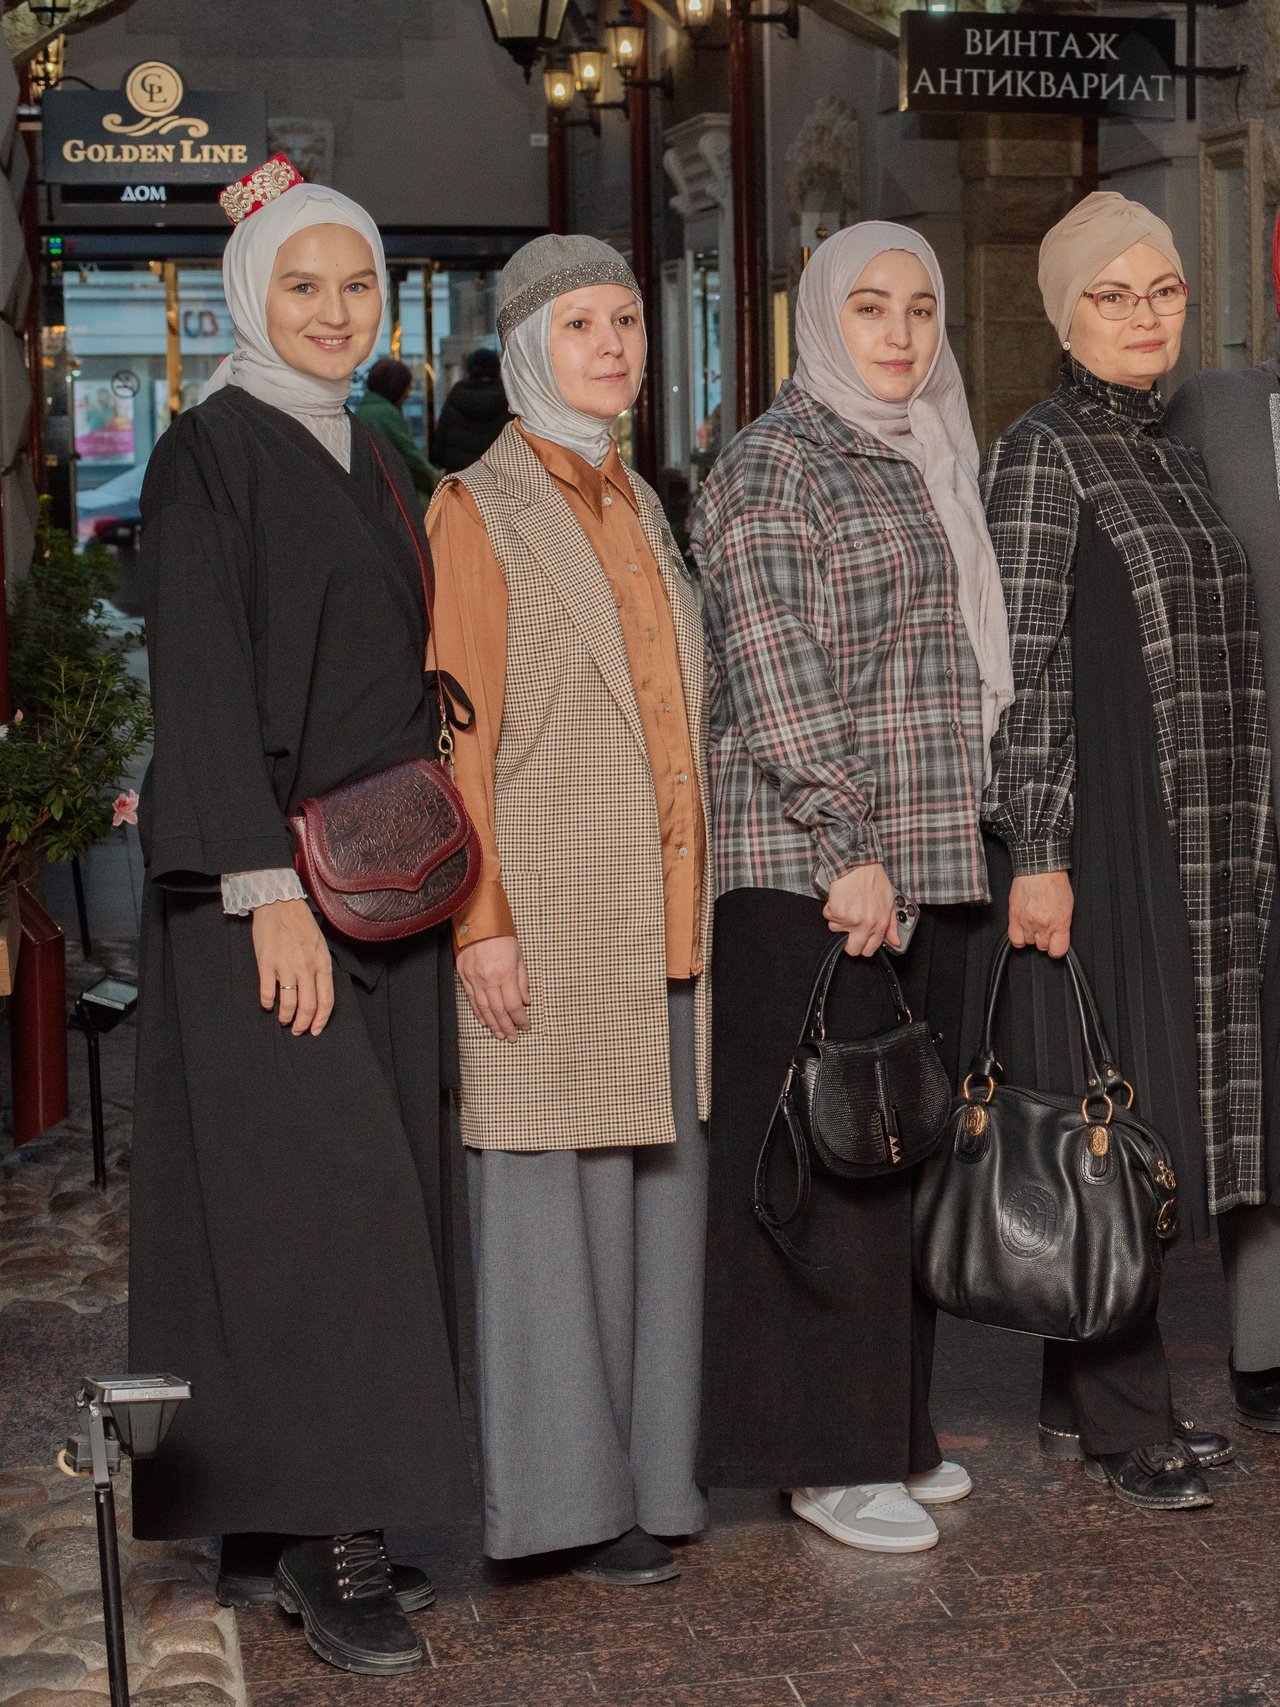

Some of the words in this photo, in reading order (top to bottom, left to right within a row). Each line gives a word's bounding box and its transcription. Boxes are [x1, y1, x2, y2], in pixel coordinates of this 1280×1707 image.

[964, 28, 1119, 60] ВИНТАЖ
[912, 68, 1172, 101] АНТИКВАРИАТ
[62, 140, 175, 163] GOLDEN
[180, 140, 248, 163] LINE
[120, 185, 167, 202] ДОМ
